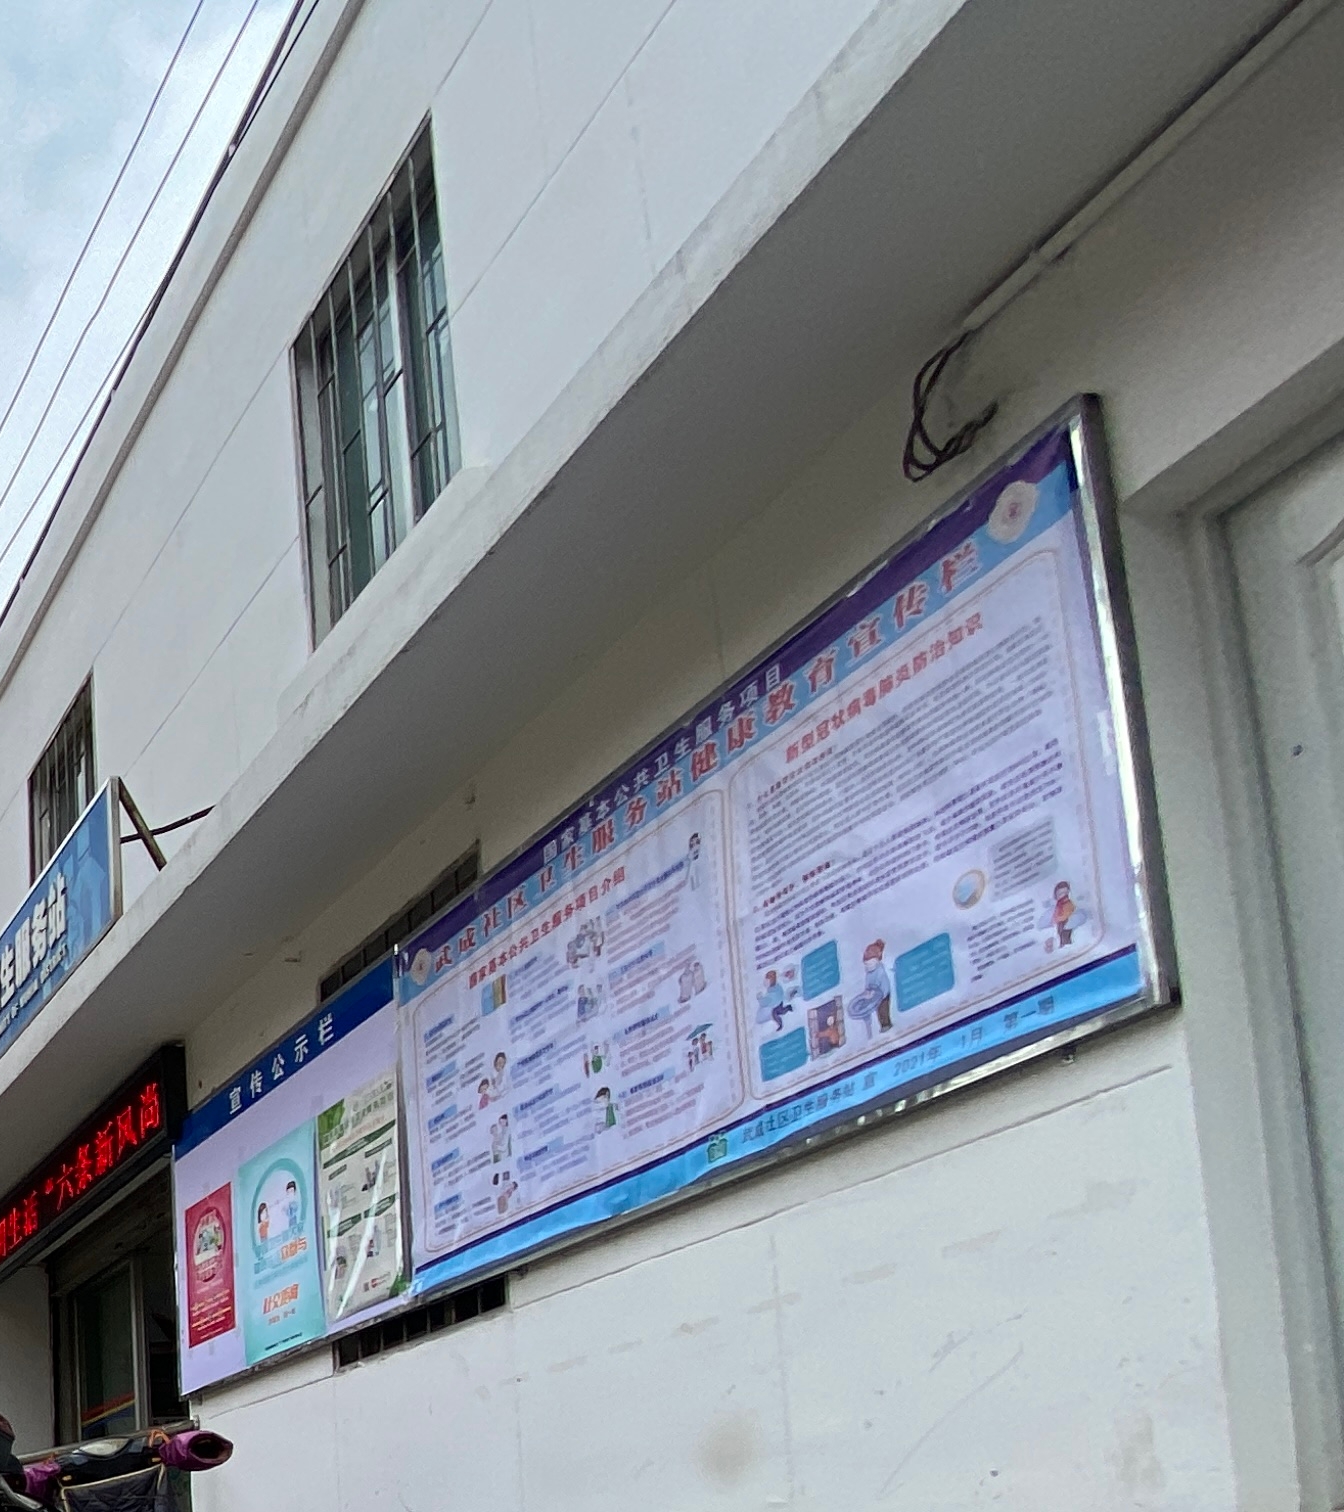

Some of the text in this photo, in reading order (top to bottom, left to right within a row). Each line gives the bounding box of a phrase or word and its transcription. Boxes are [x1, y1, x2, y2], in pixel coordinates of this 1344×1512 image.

[229, 1013, 336, 1115] 宣传公示栏
